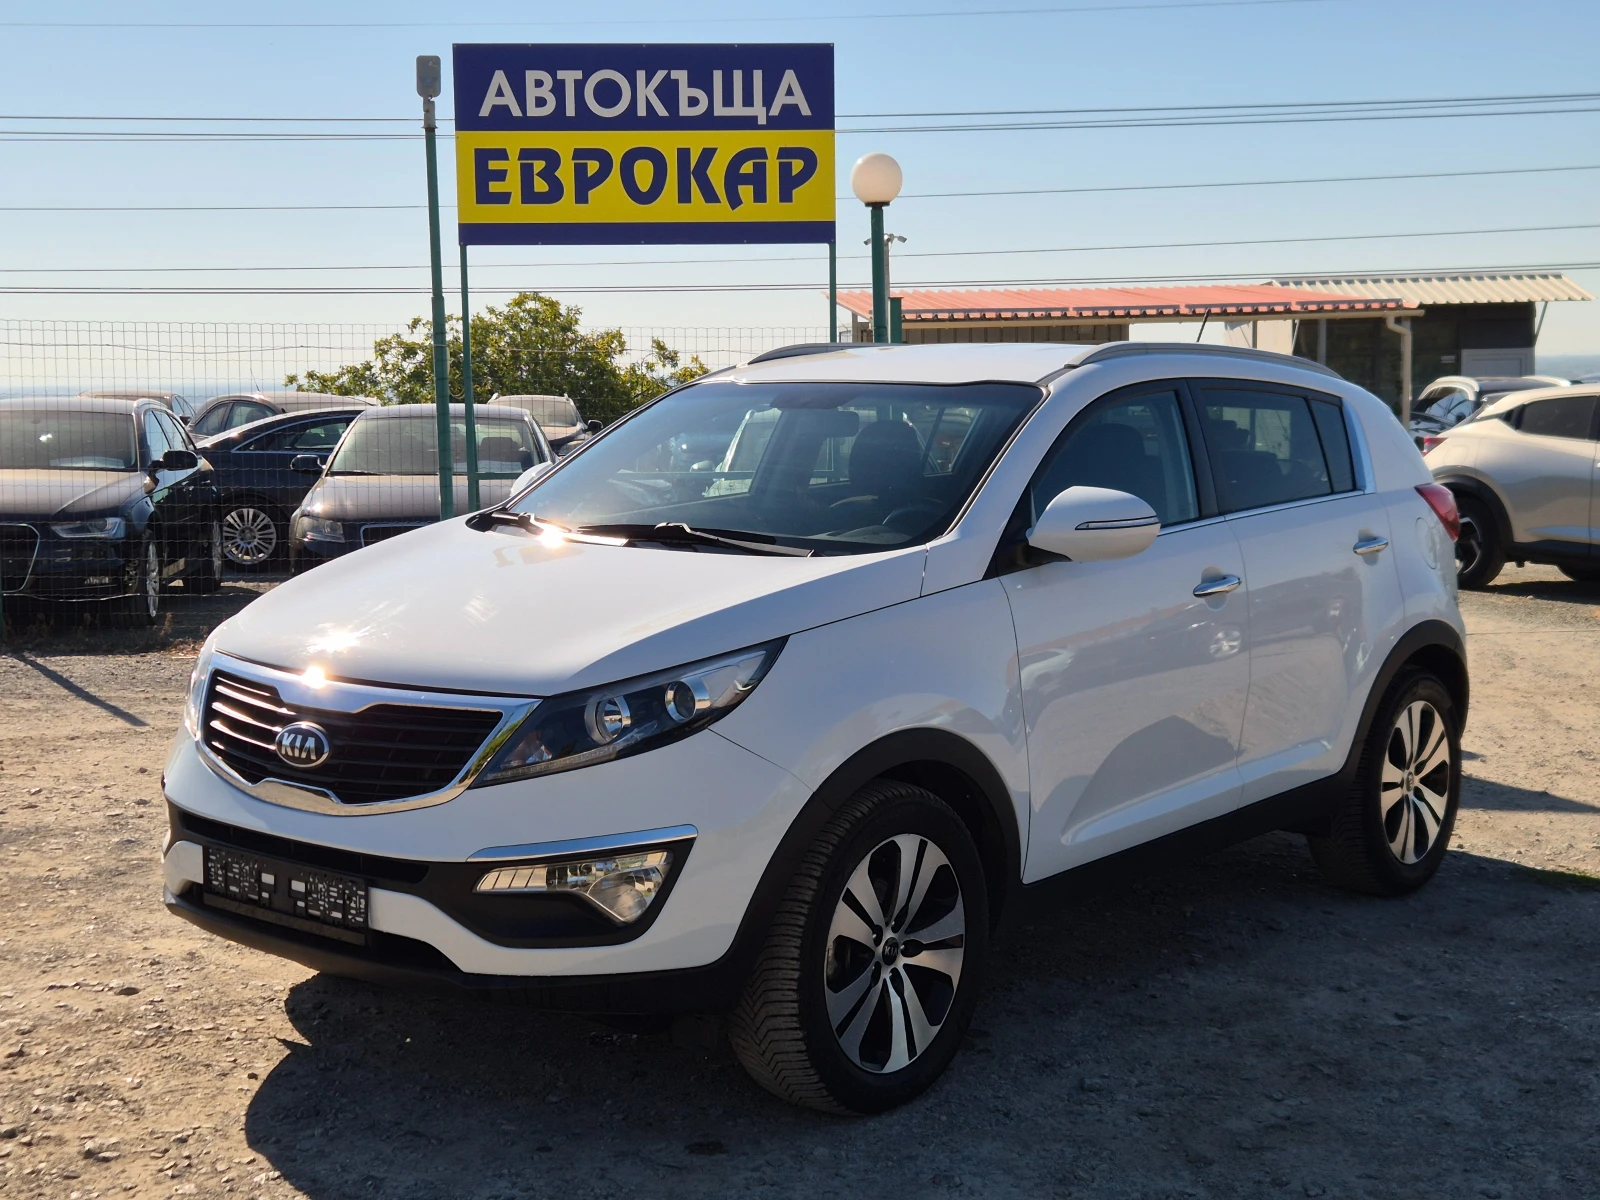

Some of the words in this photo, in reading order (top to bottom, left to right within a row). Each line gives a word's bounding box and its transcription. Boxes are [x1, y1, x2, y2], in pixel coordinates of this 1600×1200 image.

[478, 68, 812, 125] АВТОКЪЩА
[473, 146, 818, 211] ЕВРОКАР
[281, 732, 317, 760] KIA
